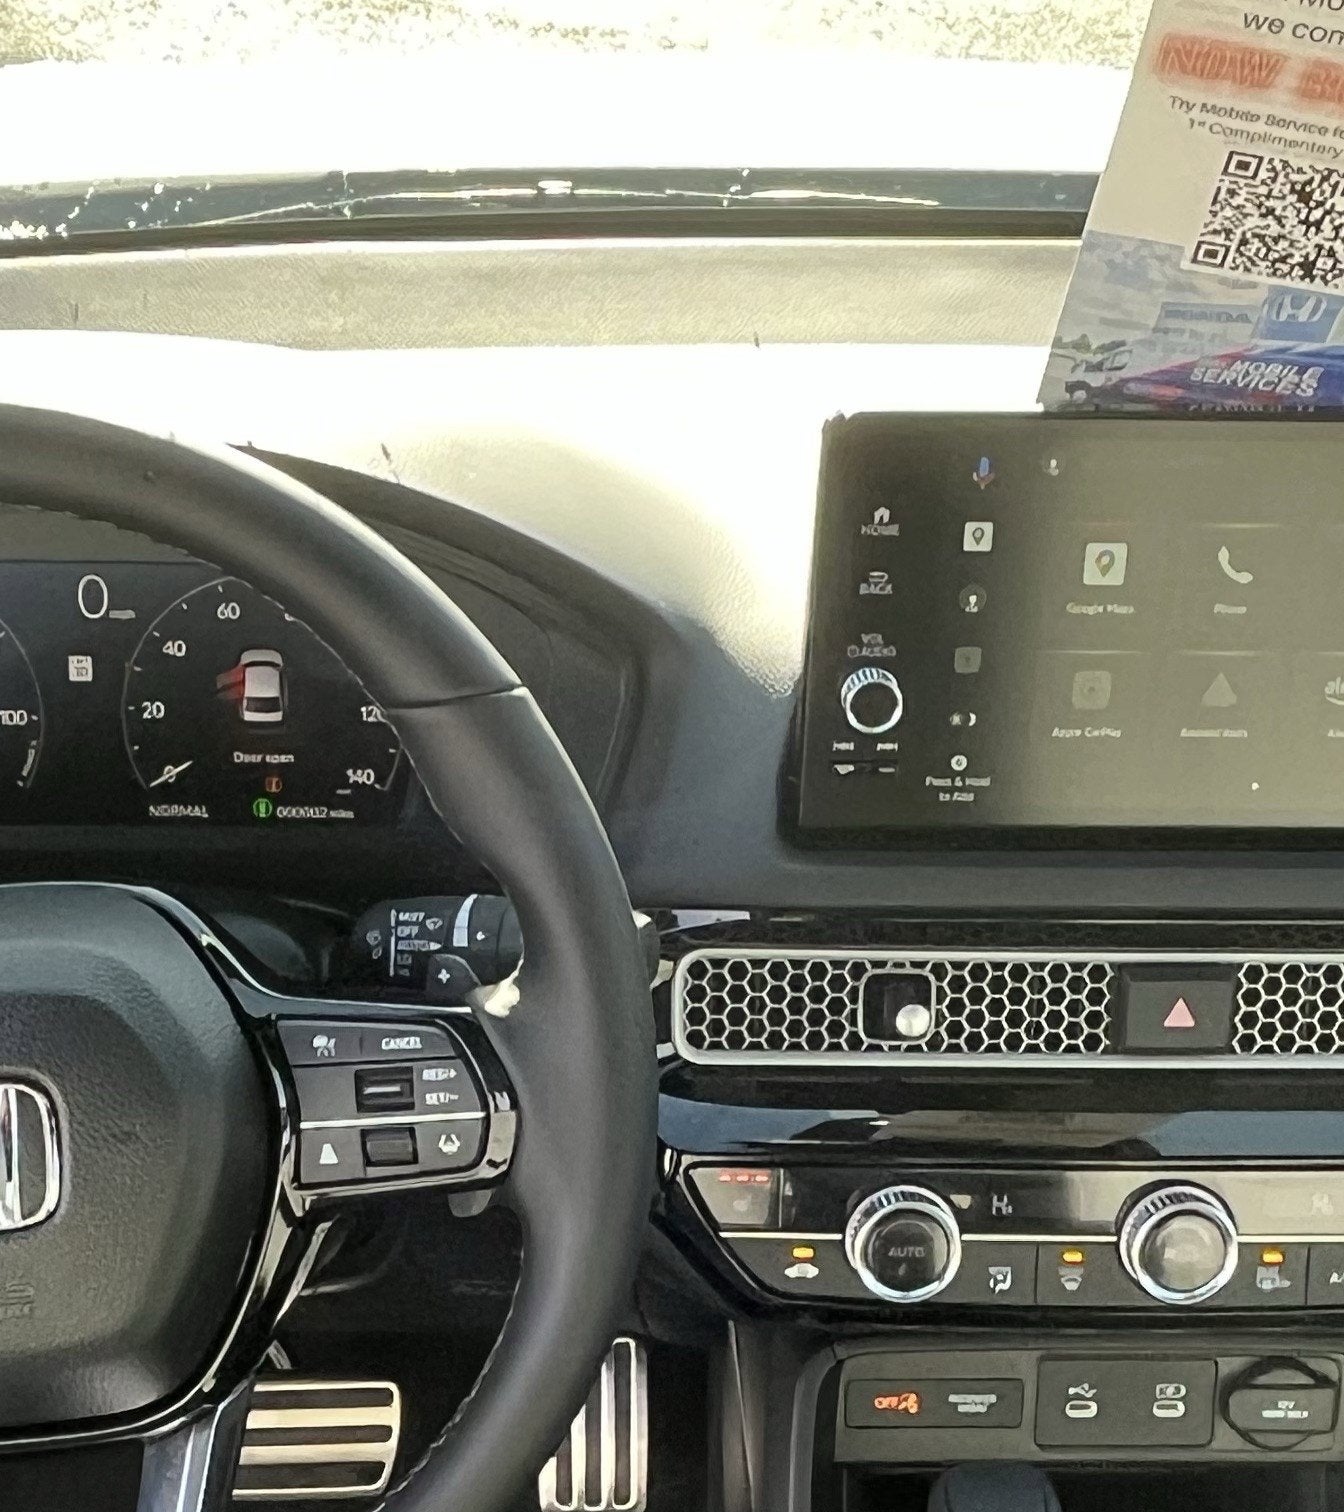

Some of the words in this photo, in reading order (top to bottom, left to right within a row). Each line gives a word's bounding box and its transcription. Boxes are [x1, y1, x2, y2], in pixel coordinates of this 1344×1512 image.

[1244, 12, 1285, 35] we
[77, 574, 109, 620] 0
[216, 602, 241, 620] 60
[162, 640, 187, 658] 40
[141, 701, 165, 719] 20
